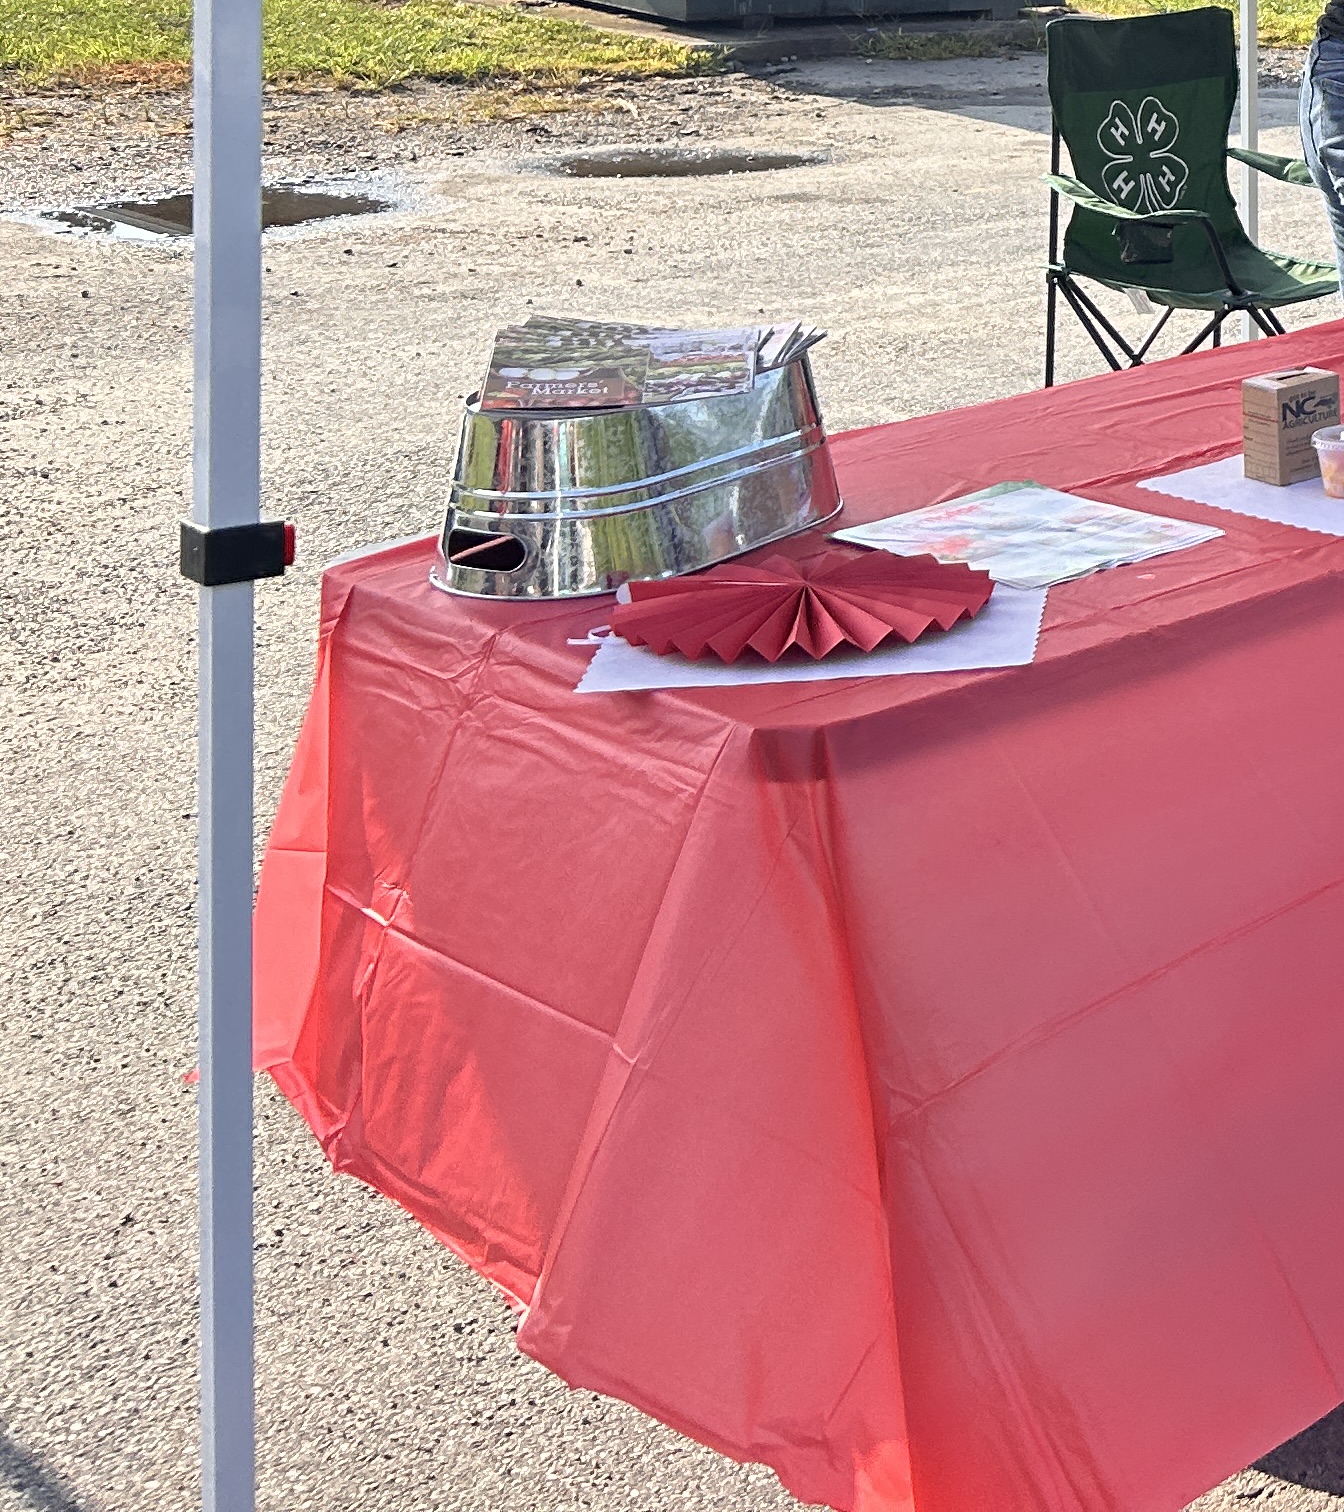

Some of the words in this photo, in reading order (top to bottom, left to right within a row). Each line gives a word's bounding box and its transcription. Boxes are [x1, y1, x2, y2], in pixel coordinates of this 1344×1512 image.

[506, 379, 605, 389] Farmers'
[531, 386, 610, 395] Market
[1282, 396, 1316, 421] NC
[1283, 409, 1338, 430] AGRICULTURE
